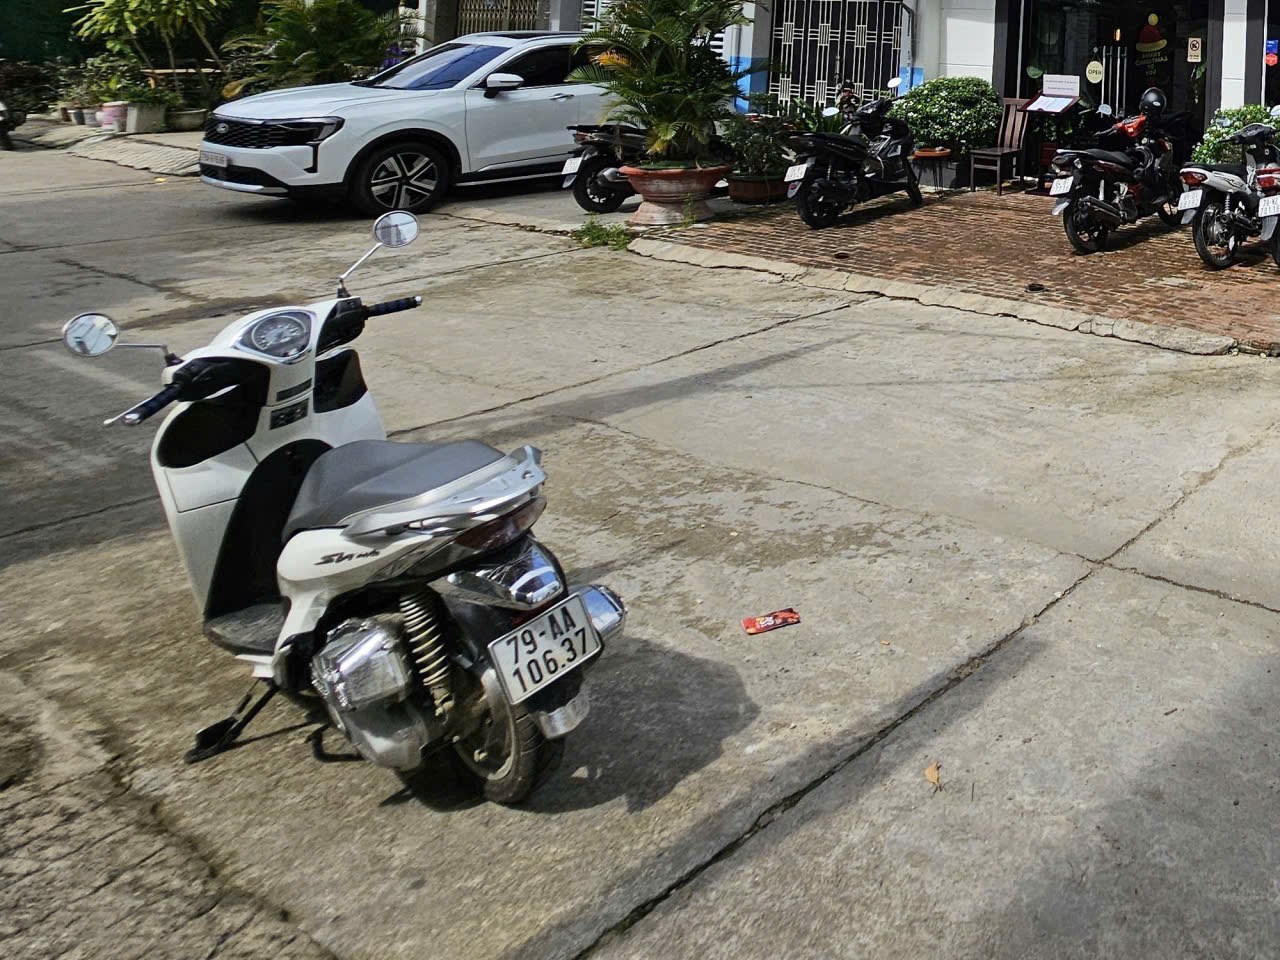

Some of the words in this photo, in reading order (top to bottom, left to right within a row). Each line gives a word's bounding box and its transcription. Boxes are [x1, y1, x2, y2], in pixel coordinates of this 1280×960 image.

[1087, 68, 1103, 76] OPEN
[505, 605, 577, 666] 79-AA
[512, 626, 587, 694] 106.37
